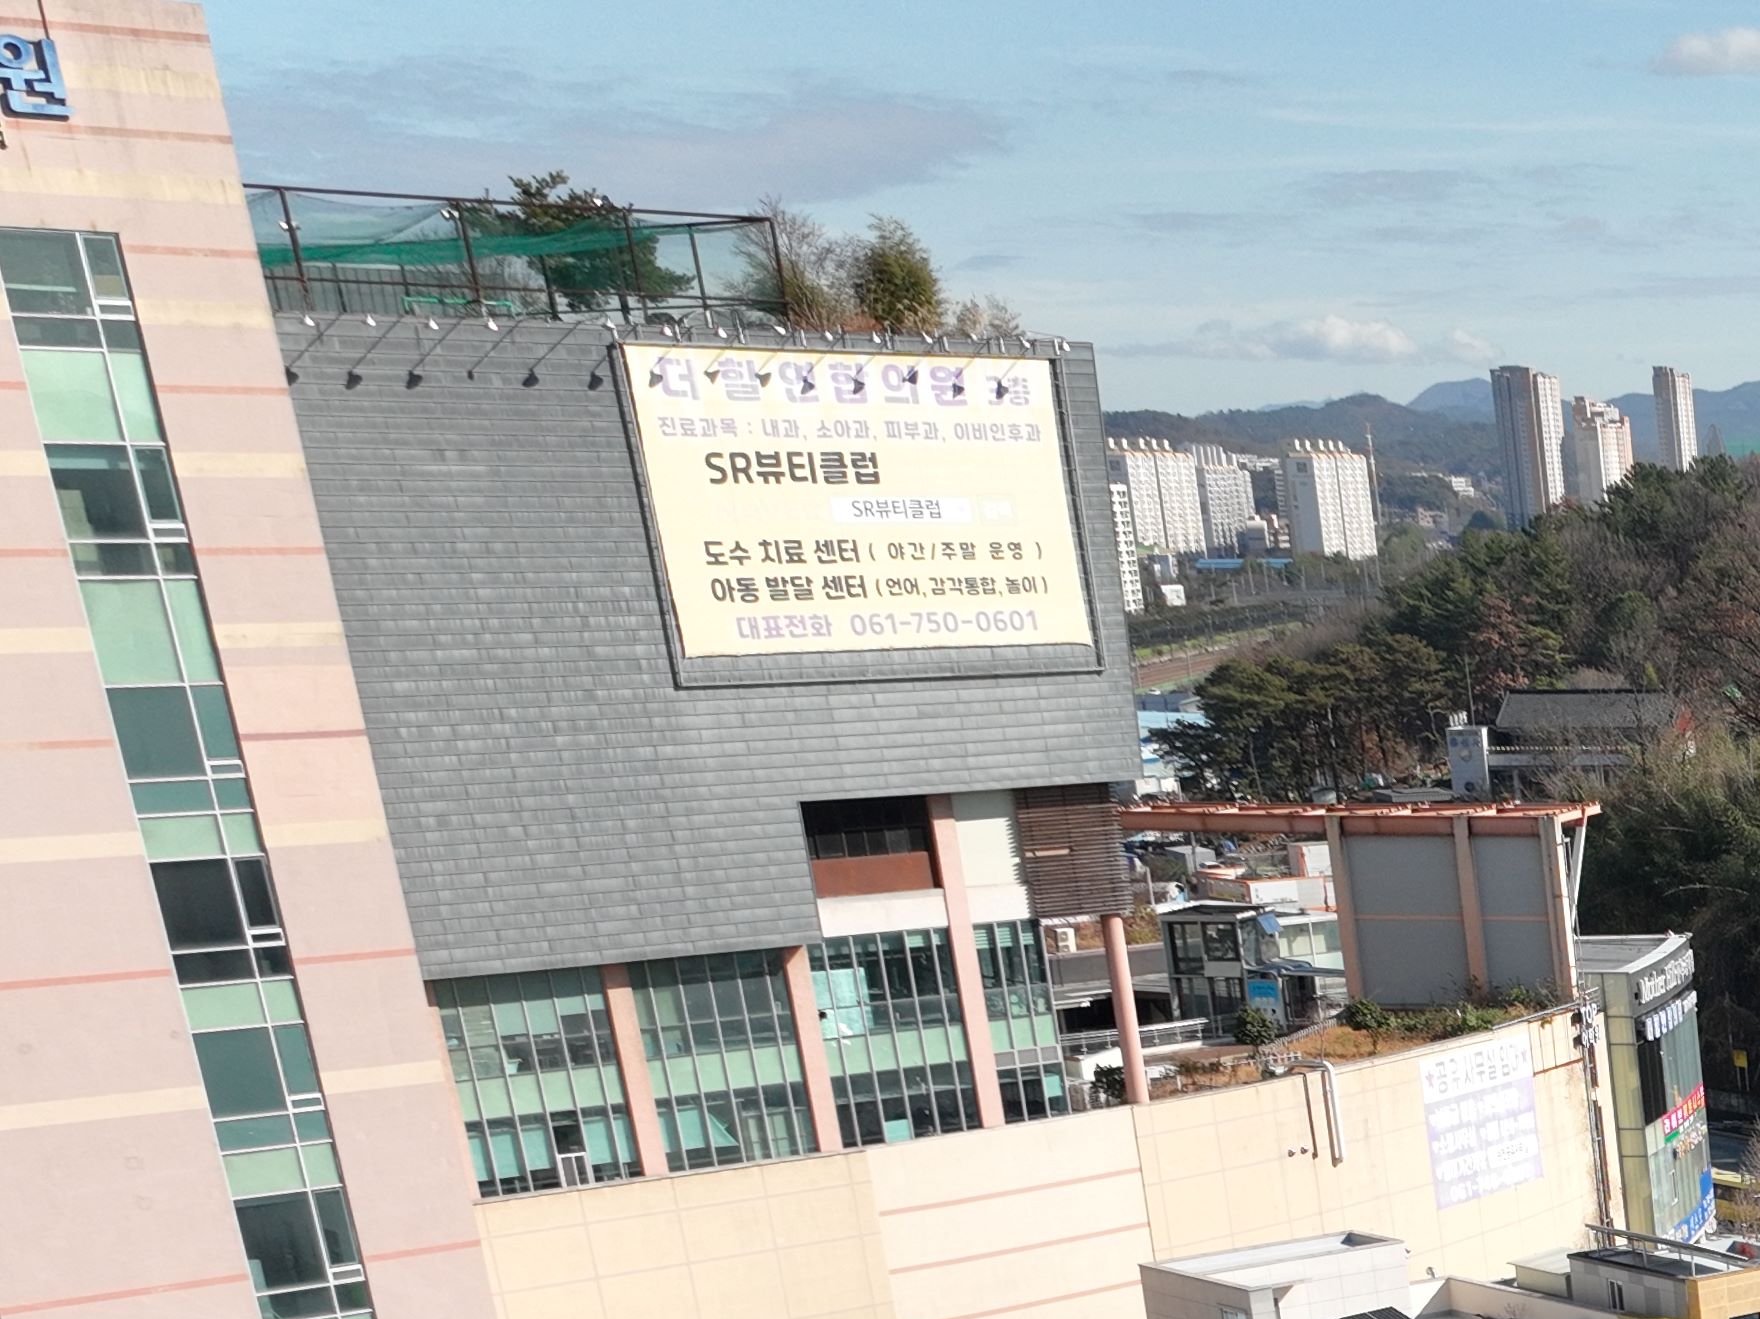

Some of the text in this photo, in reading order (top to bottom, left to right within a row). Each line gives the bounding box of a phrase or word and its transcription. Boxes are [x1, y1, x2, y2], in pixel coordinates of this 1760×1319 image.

[658, 415, 1041, 444] 진료과목 내과, 소아과, 피부과, 이비인후과
[705, 451, 881, 485] SR뷰티클럽
[851, 499, 942, 519] SR뷰티클럽
[704, 539, 751, 566] 도수
[758, 538, 804, 564] 치료
[813, 537, 859, 564] 센터
[989, 539, 1024, 561] 운영
[711, 578, 759, 604] 아동
[766, 577, 813, 603] 발달
[821, 575, 867, 601] 센터
[736, 609, 1039, 639] 대표전화 061-750-0601
